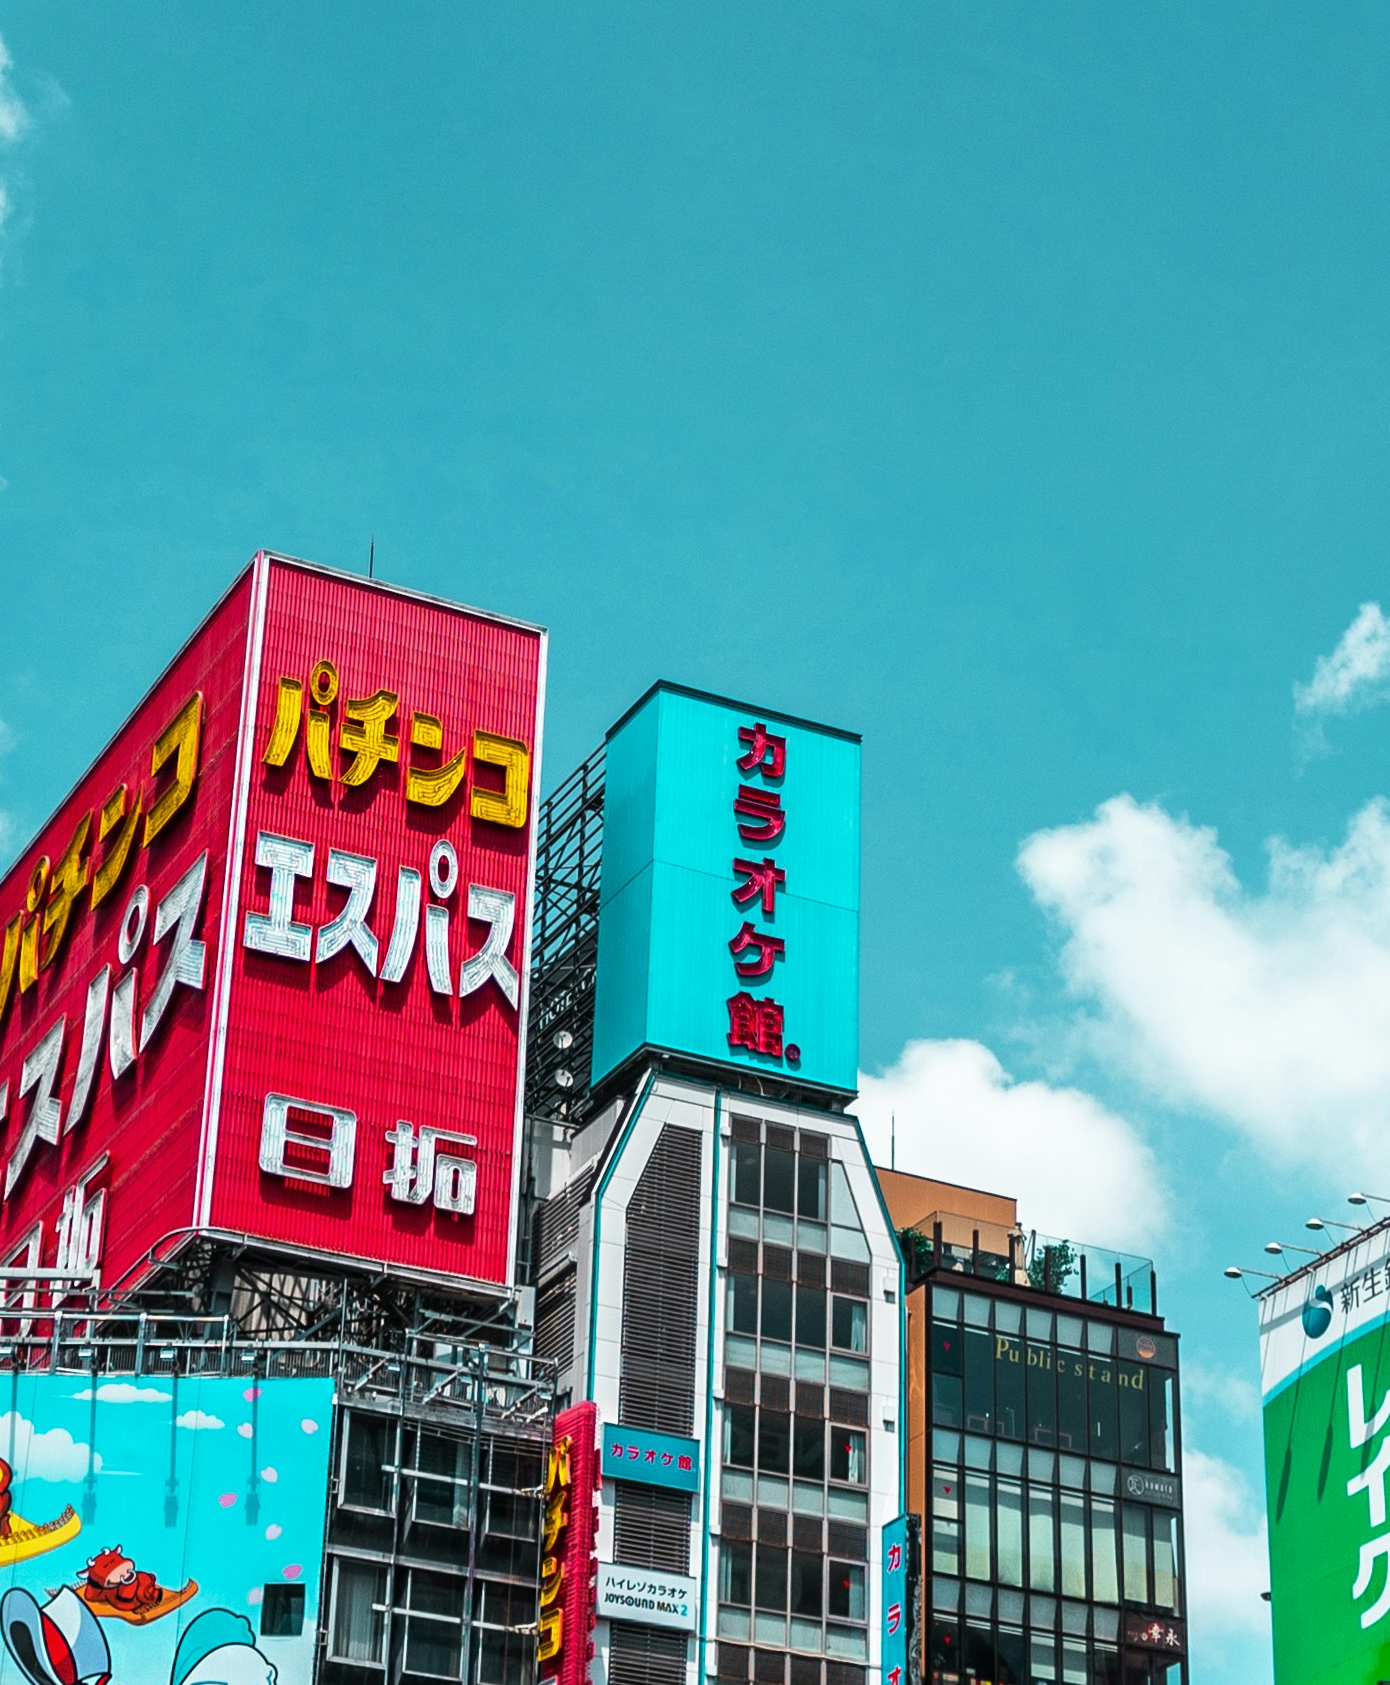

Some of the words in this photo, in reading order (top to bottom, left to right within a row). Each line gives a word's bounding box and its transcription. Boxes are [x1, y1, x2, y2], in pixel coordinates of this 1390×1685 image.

[260, 659, 531, 830] パチンコ
[243, 838, 519, 1011] エスパス
[258, 1092, 479, 1216] 日拓
[1074, 1363, 1144, 1390] stand
[611, 1442, 693, 1471] カラオケ館
[540, 1435, 573, 1663] パチンコ
[604, 1594, 656, 1611] JOYSOUND
[656, 1600, 679, 1614] MAX
[605, 1576, 688, 1600] ハイレゾカラオケ
